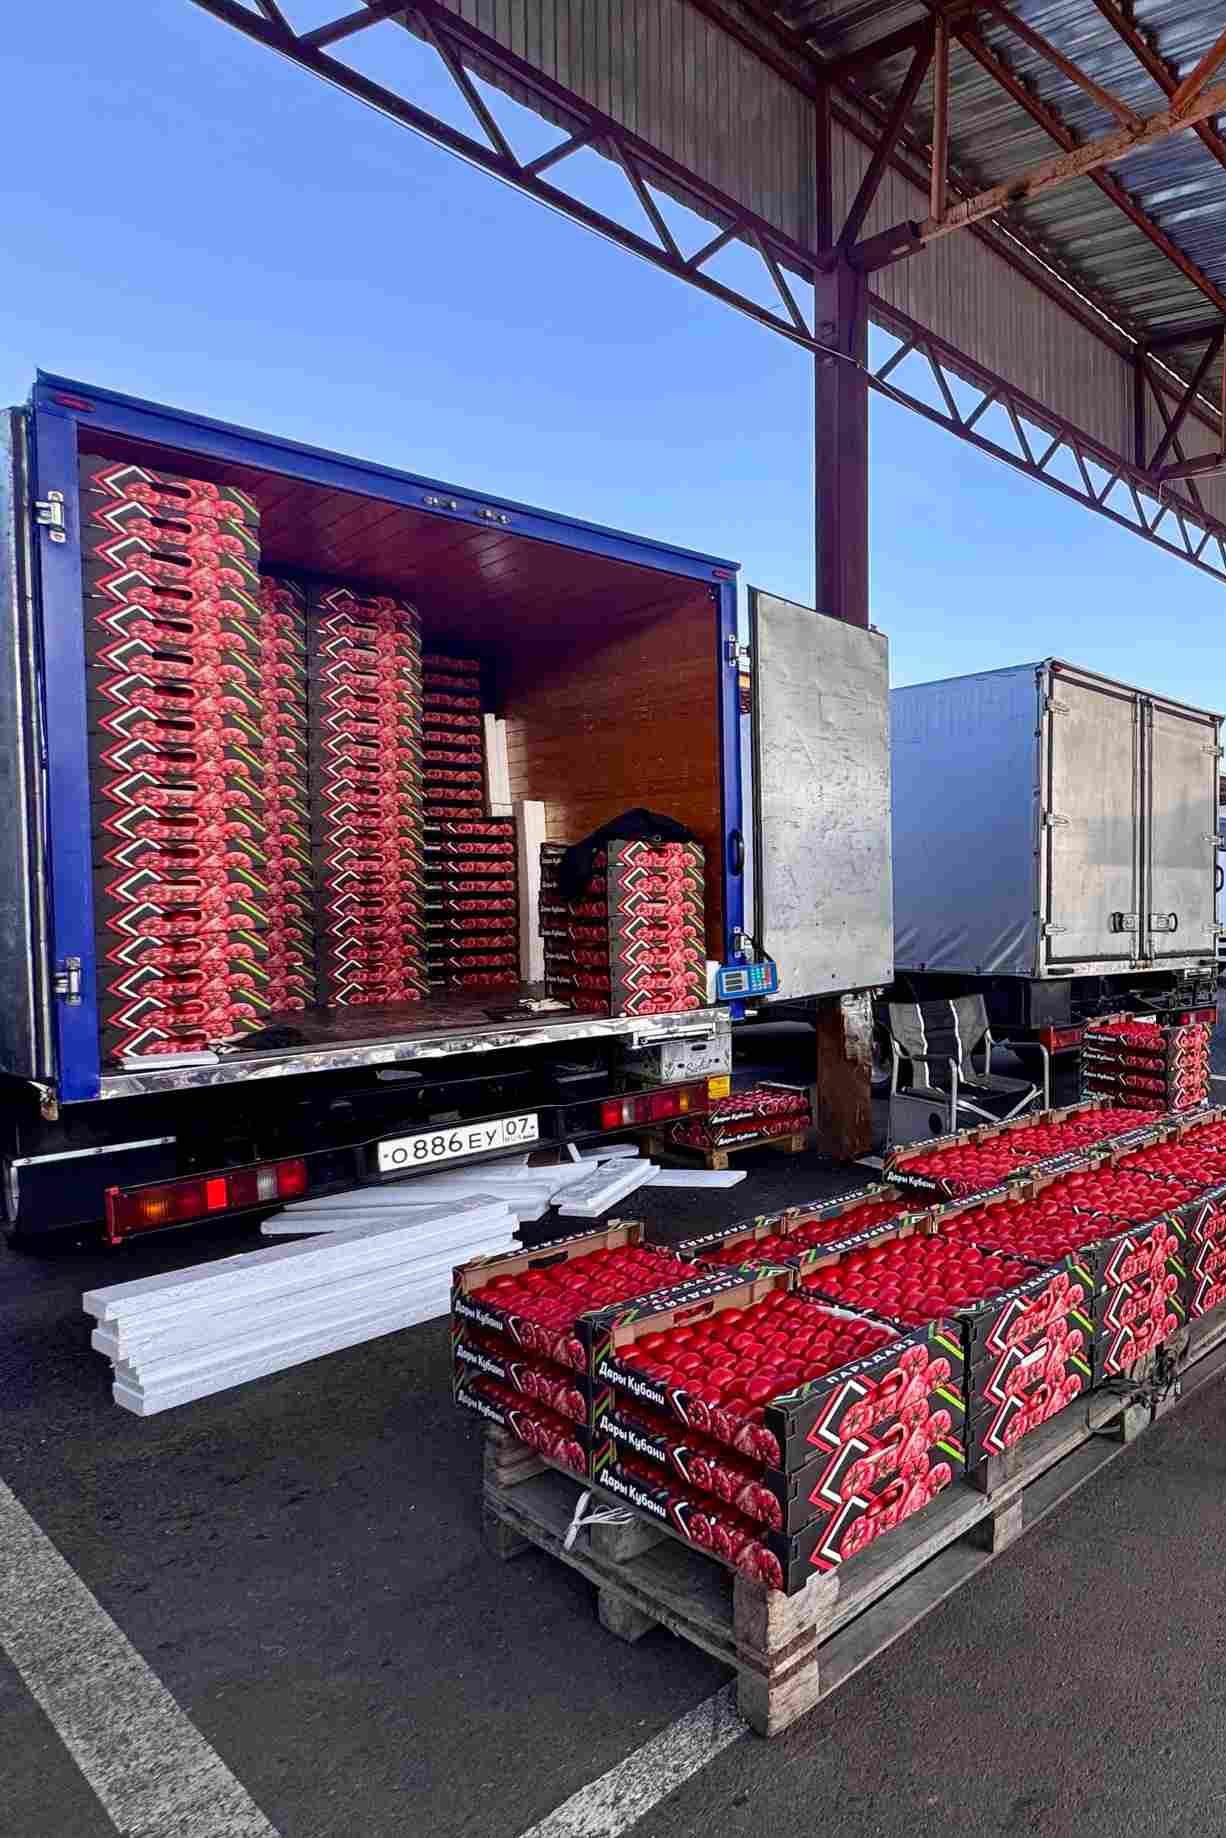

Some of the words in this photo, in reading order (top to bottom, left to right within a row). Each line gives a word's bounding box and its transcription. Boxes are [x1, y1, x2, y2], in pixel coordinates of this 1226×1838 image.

[506, 1118, 528, 1136] 07
[599, 1361, 627, 1388] Дары
[627, 1375, 665, 1406] Кубани
[826, 1339, 915, 1384] ПАРАДАЙЗ
[599, 1415, 627, 1441] Дары
[628, 1432, 666, 1463] Кубани
[600, 1469, 628, 1496] Дары
[629, 1485, 667, 1519] Кубани
